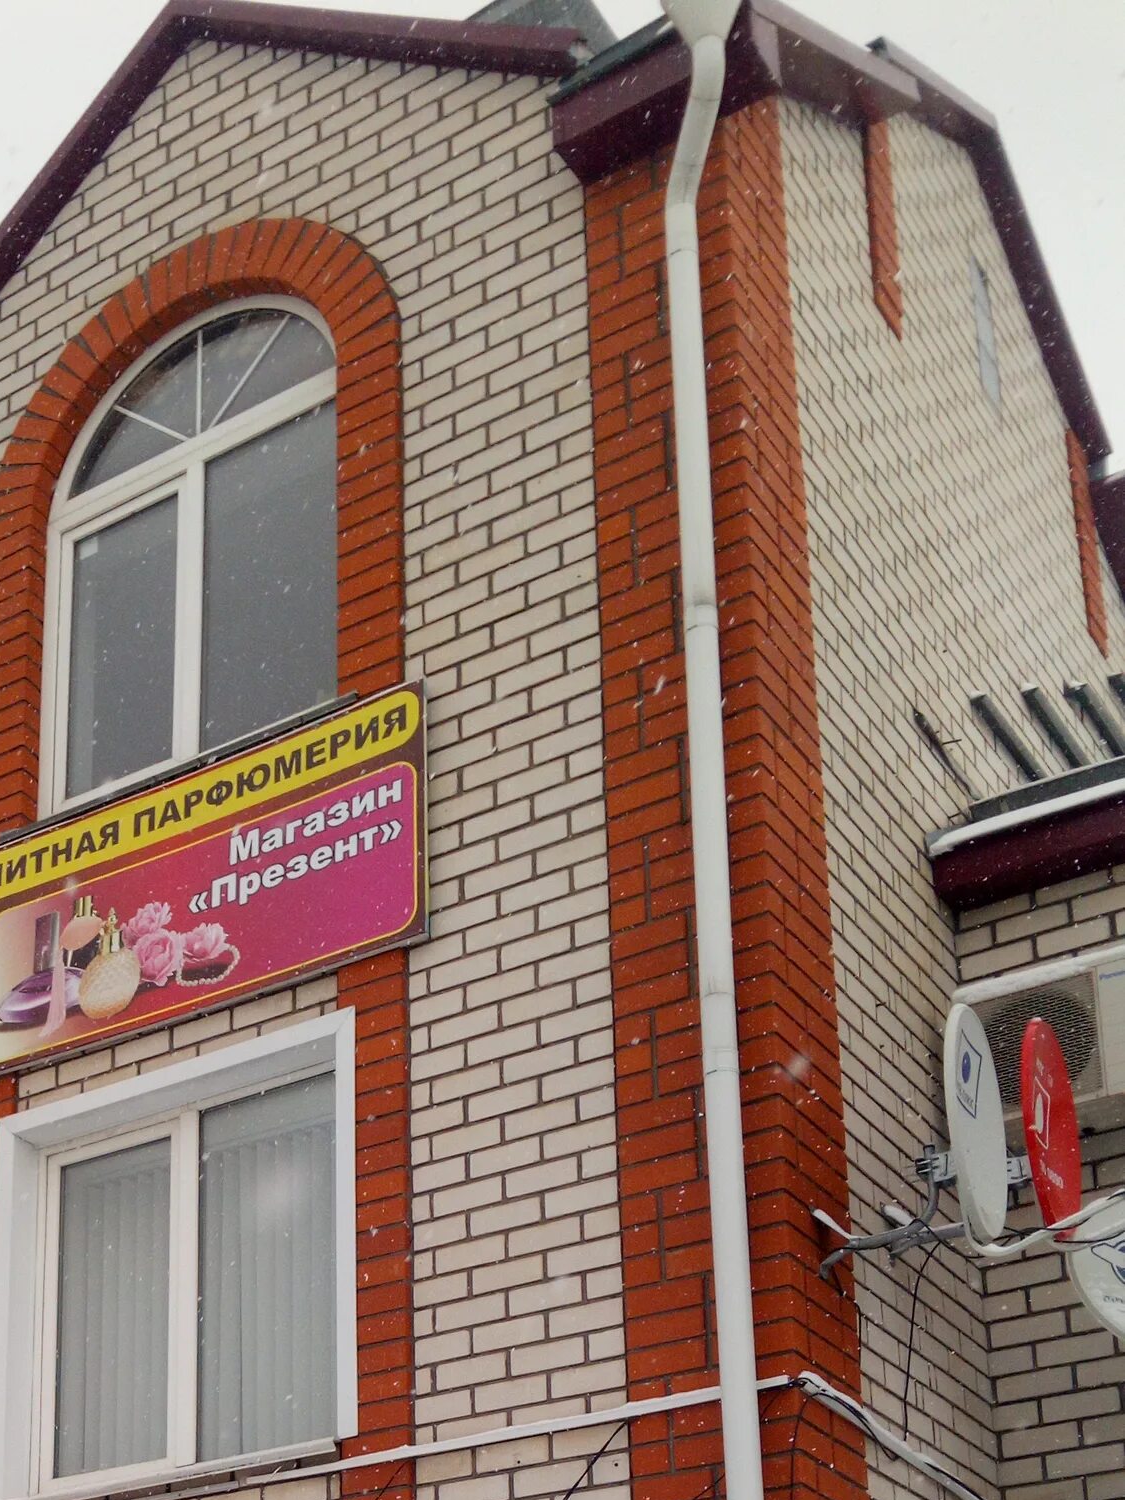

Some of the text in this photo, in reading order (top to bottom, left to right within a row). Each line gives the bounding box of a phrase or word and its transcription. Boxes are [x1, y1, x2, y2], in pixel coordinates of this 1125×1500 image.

[133, 702, 408, 838] ПАРФЮМЕРИЯ
[187, 818, 402, 916] «Презент»
[229, 779, 402, 865] Магазин
